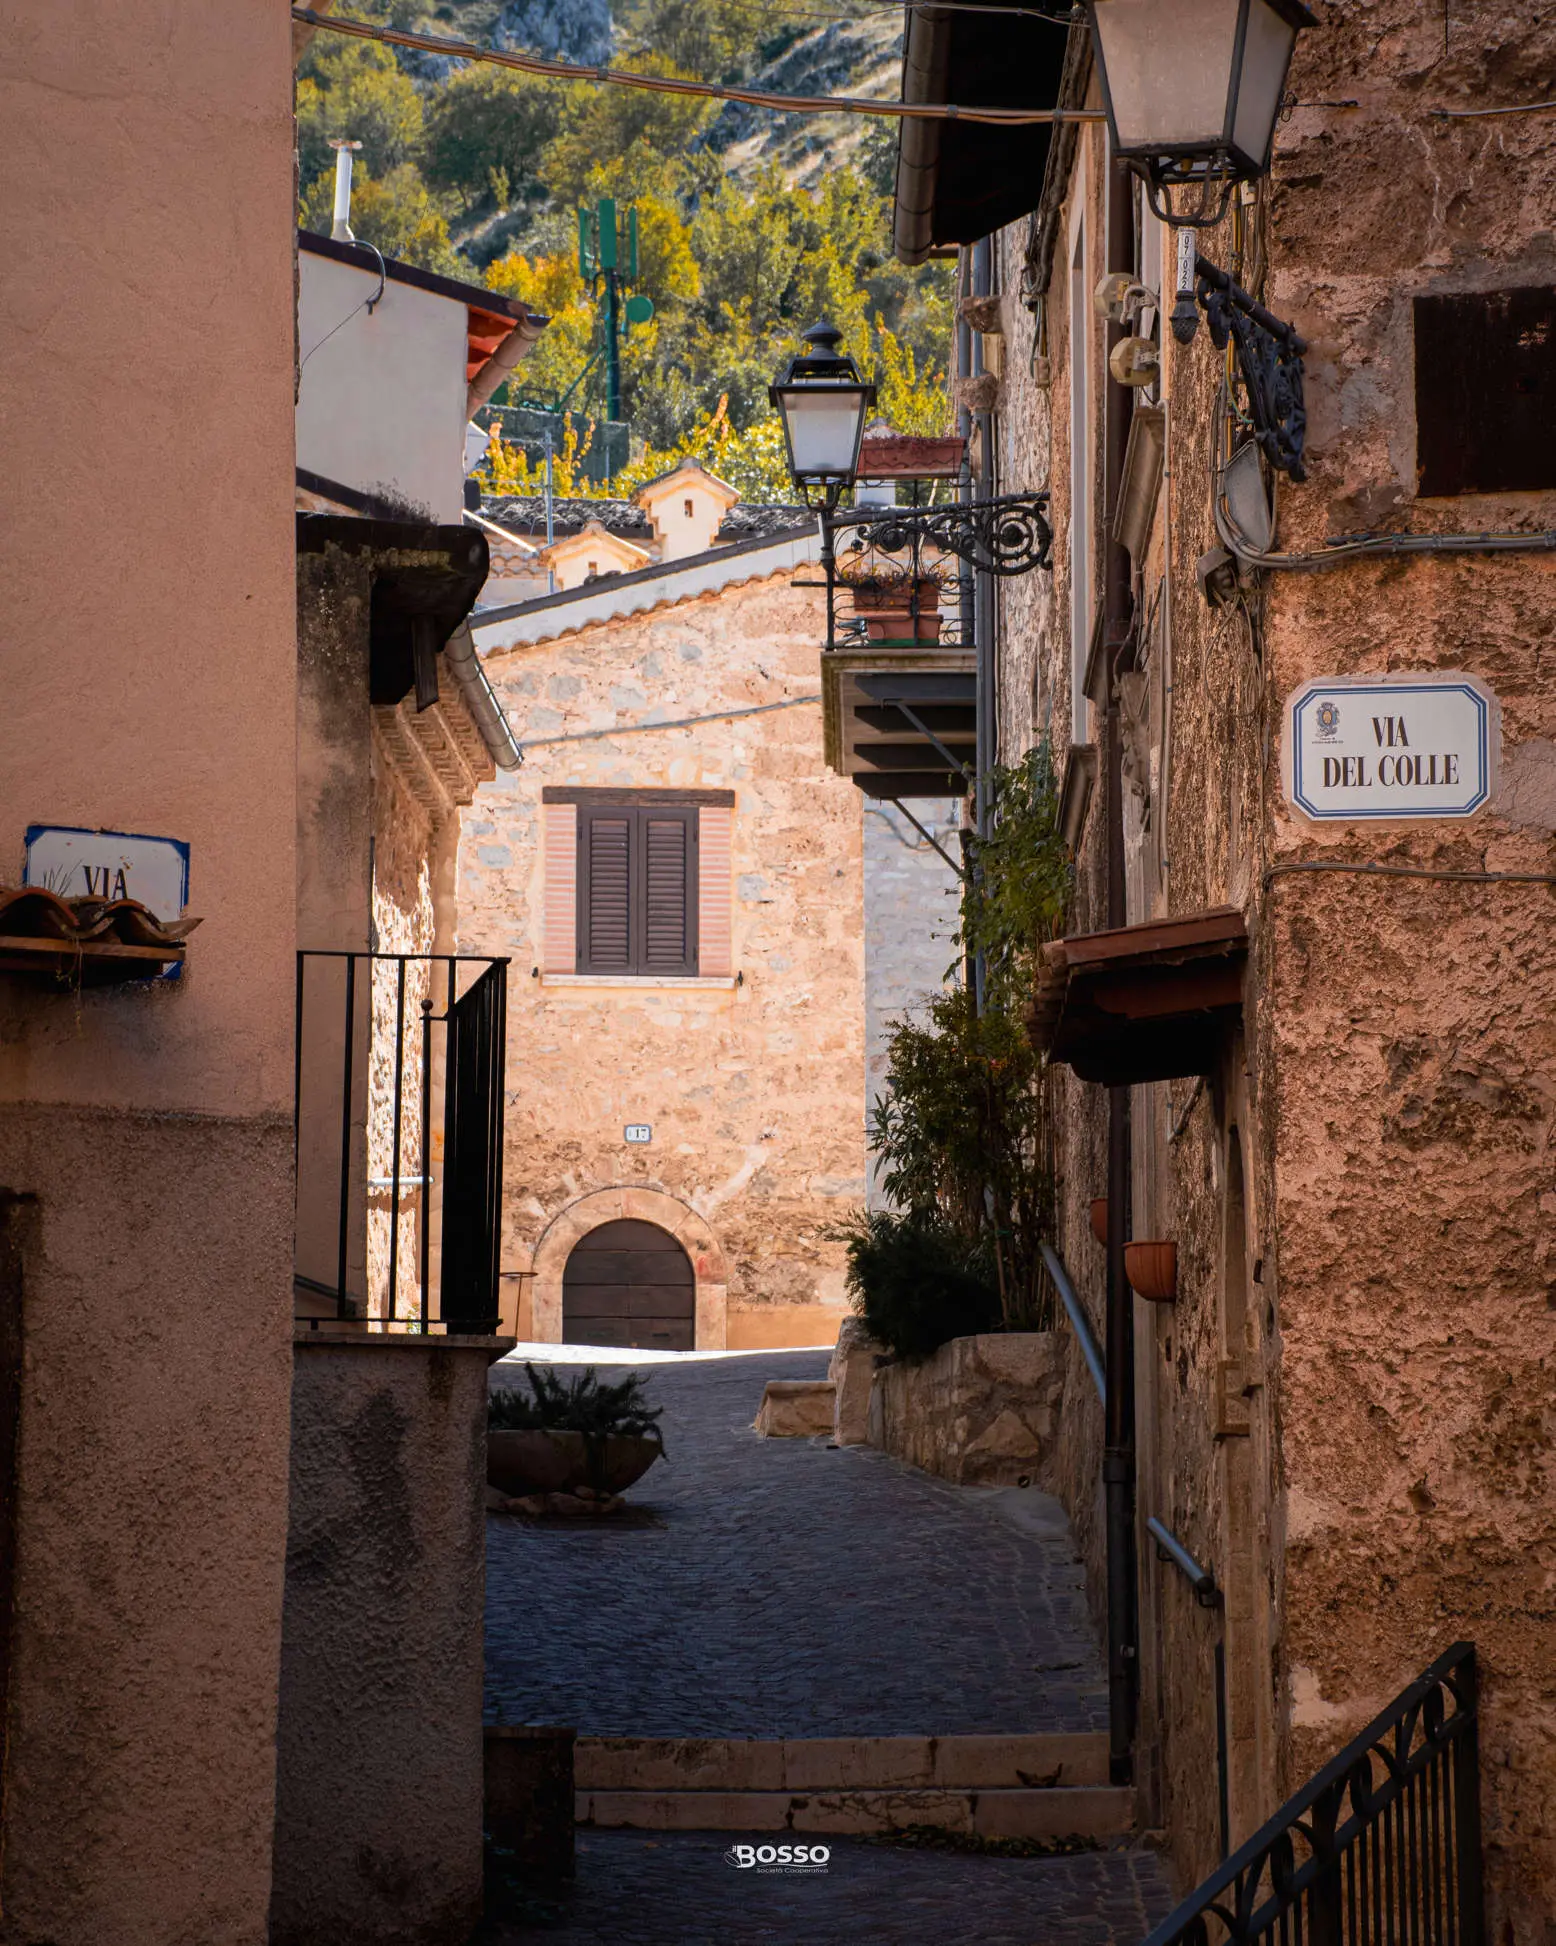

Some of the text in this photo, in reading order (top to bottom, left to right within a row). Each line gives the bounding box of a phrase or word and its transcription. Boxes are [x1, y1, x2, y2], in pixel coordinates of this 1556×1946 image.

[1371, 715, 1410, 747] VIA
[1322, 754, 1460, 788] DEL COLLE
[82, 864, 129, 900] VIA
